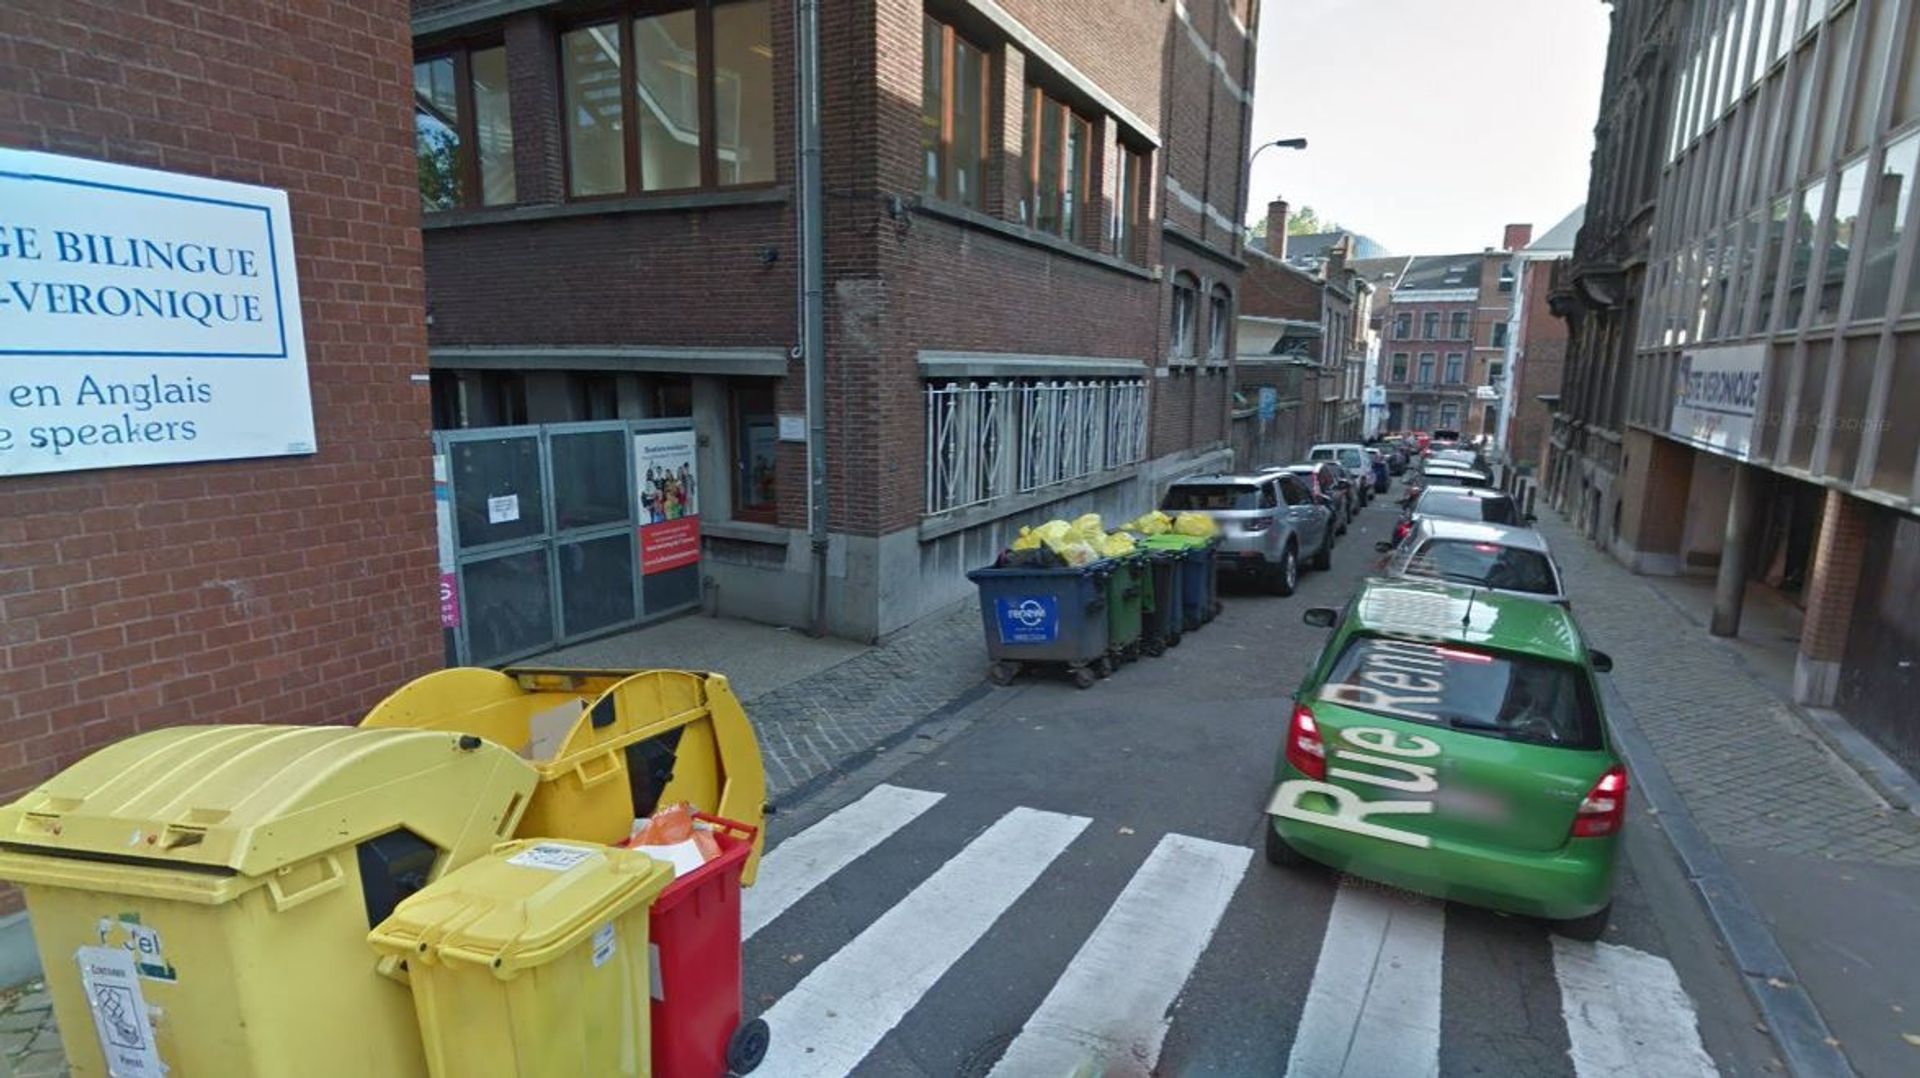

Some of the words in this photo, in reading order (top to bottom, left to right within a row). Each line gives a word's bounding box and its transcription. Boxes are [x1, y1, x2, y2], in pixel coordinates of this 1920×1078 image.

[54, 230, 258, 278] BILINGUE
[9, 383, 60, 408] en
[76, 373, 212, 412] Anglais
[29, 413, 197, 456] speakers
